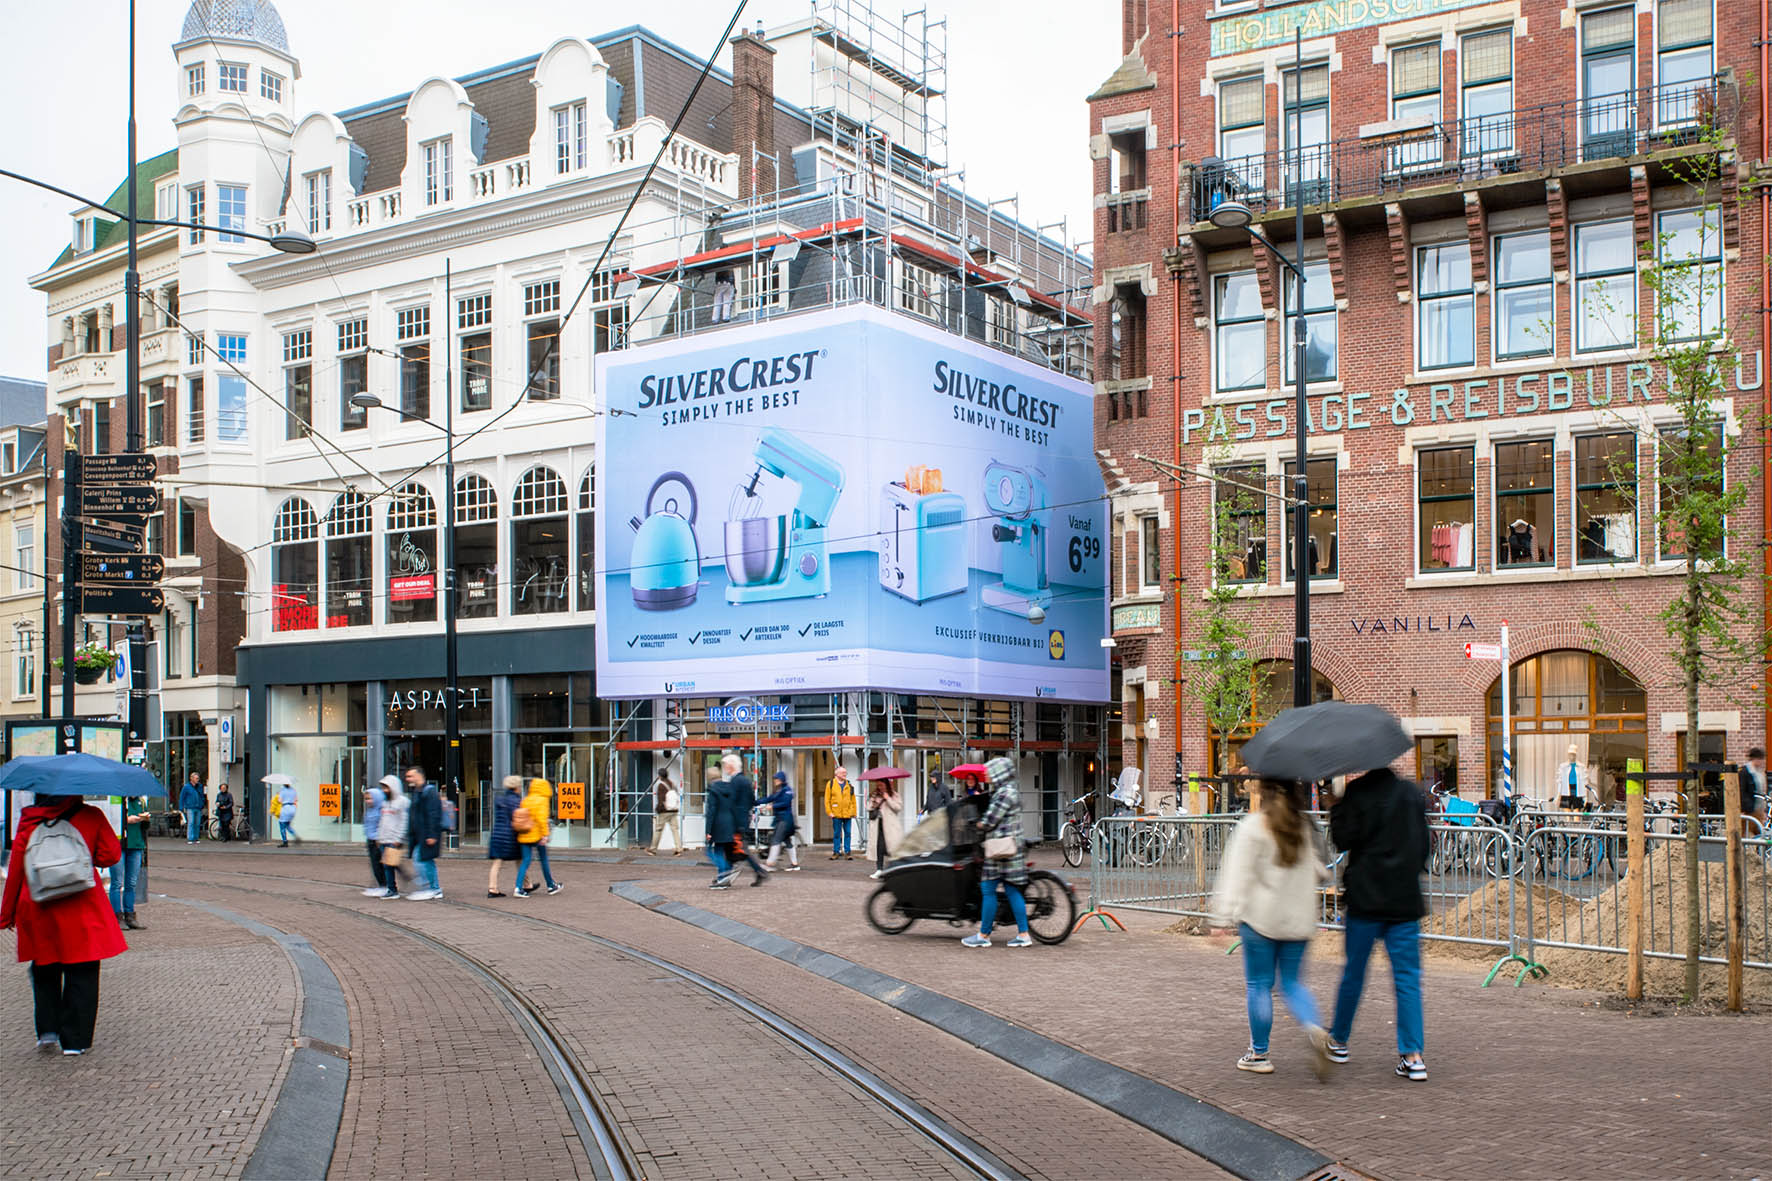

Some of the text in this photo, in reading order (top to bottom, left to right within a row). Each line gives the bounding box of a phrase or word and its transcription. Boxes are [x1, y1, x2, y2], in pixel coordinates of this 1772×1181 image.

[662, 390, 800, 426] SIMPLY THE BEST
[953, 405, 1049, 446] SIMPLY THE BEST
[1069, 514, 1092, 531] Vanaf
[814, 620, 844, 629] DE LAAGSTE
[1351, 614, 1475, 634] VANILIA
[640, 633, 677, 641] HOOGWAARDIGE
[702, 629, 731, 637] INNOVATIEF
[814, 629, 829, 637] PRIJS
[703, 637, 720, 645] DESIGN
[935, 626, 1044, 649] EXCLUSIEF VERKRIJGBAAR BIJ
[321, 787, 338, 795] SALE
[561, 787, 581, 796] SALE
[321, 800, 339, 808] 70%
[561, 801, 582, 809] 70%
